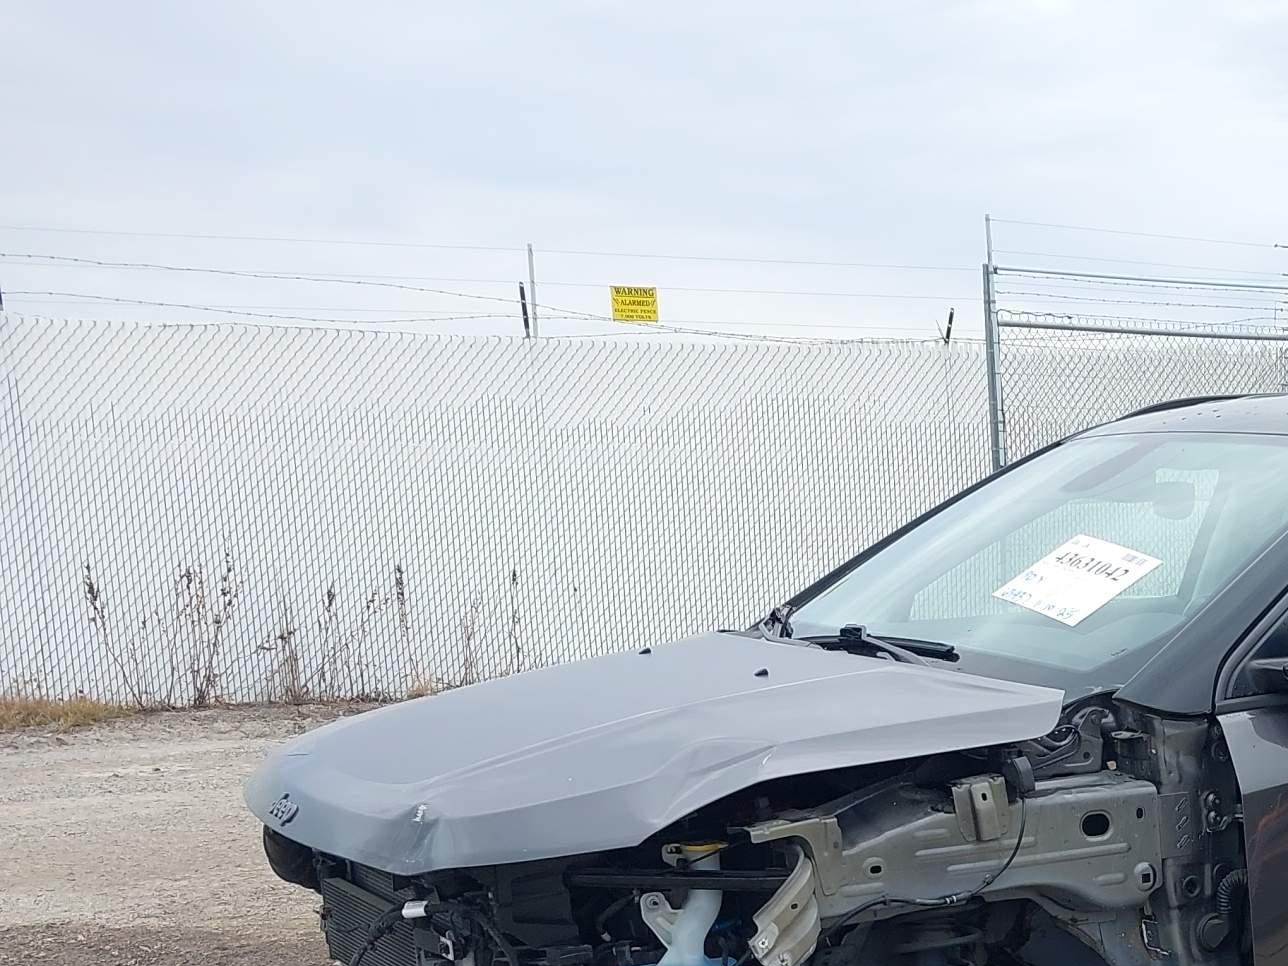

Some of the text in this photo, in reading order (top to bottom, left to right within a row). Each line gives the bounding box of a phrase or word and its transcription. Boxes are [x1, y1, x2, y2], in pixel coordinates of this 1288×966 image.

[614, 287, 654, 297] WARNING
[621, 299, 650, 307] ALARMED
[1055, 551, 1131, 582] 43631042
[268, 792, 300, 827] Jeep
